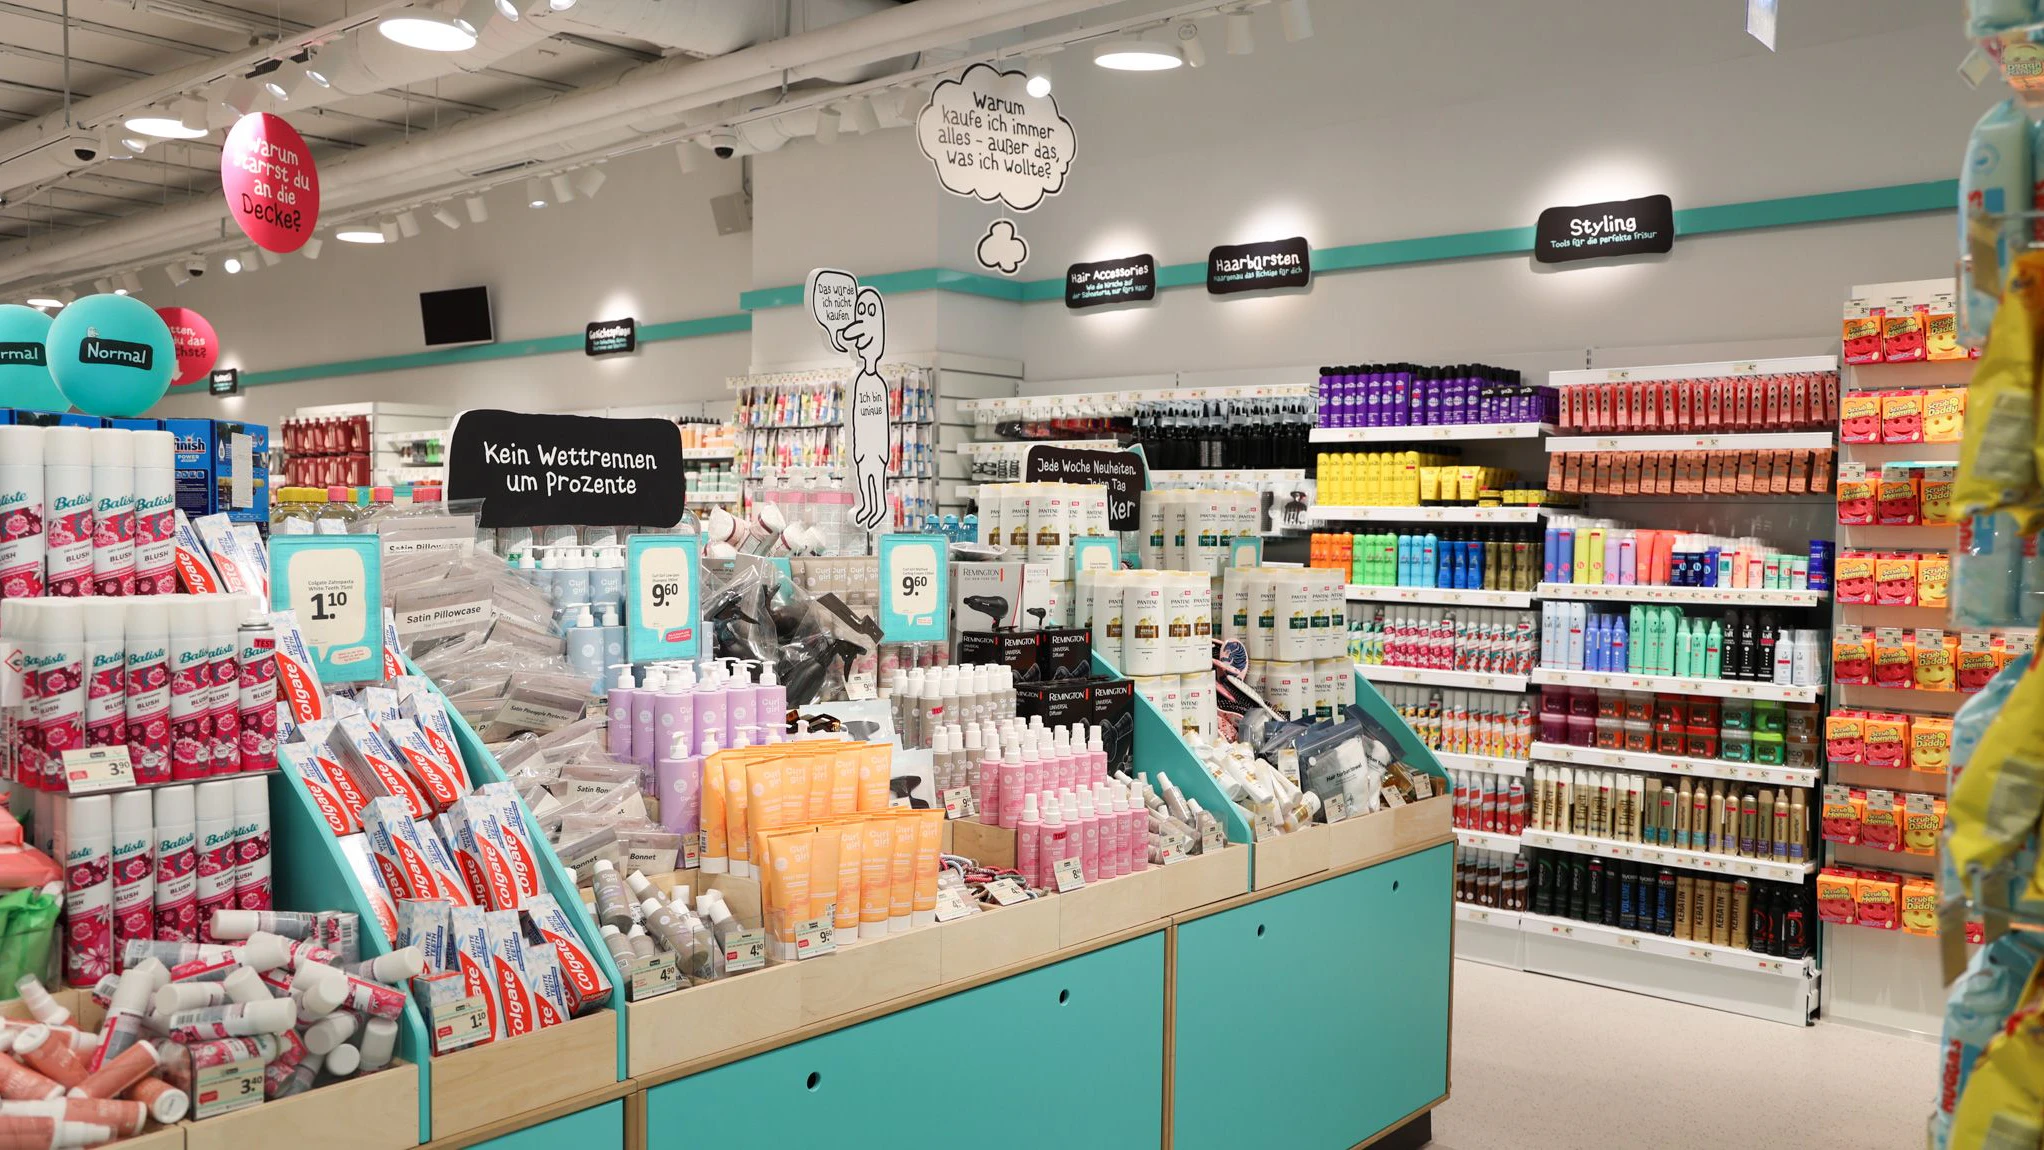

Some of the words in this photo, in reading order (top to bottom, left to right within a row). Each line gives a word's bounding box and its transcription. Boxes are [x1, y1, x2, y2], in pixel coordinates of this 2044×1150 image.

[942, 104, 982, 129] kaufe
[987, 114, 1007, 132] ich
[1012, 118, 1055, 139] immer
[938, 127, 971, 146] alles
[987, 136, 1029, 155] außer
[1034, 142, 1060, 163] das,
[979, 152, 999, 171] ich
[294, 170, 311, 191] du
[254, 179, 273, 199] an
[276, 184, 297, 206] die
[242, 193, 302, 233] Decke?
[1570, 215, 1637, 237] Styling
[1550, 239, 1571, 249] Tools
[1572, 237, 1585, 247] für
[1586, 236, 1598, 246] die
[1599, 233, 1632, 247] perfekte
[1215, 253, 1301, 273] Haarbürsten
[1071, 271, 1092, 284] Hair
[1092, 263, 1149, 281] Accessories
[818, 283, 832, 295] Das
[833, 283, 855, 296] würde
[822, 296, 833, 308] ich
[834, 297, 852, 308] nicht
[826, 309, 850, 321] kaufen
[187, 336, 206, 346] das
[0, 347, 39, 360] rmal
[87, 341, 147, 365] Normal
[859, 392, 871, 403] Ich
[872, 391, 882, 403] bin
[860, 405, 883, 417] unique
[1928, 406, 1958, 417] Daddy
[484, 441, 531, 466] Kein
[537, 443, 658, 470] Wettrennen
[1037, 458, 1060, 473] Jede
[1062, 459, 1091, 473] Woche
[1093, 460, 1137, 476] Neuheiten.
[506, 473, 539, 493] um
[1112, 478, 1127, 492] Tag
[1109, 495, 1136, 520] ker
[144, 551, 169, 562] BLUSH
[902, 576, 928, 597] 9.60
[652, 583, 679, 608] 9.60
[310, 592, 348, 621] 1.10
[407, 613, 432, 625] Satin
[434, 605, 482, 621] Pillowcase
[1004, 637, 1036, 648] REMINGTON
[1052, 634, 1085, 645] REMINGTON
[128, 648, 166, 665] Batiste
[1918, 650, 1941, 660] Scrub
[1919, 656, 1949, 666] Daddy
[1962, 660, 1995, 669] Mommy
[287, 662, 314, 723] Colgate
[1049, 691, 1085, 701] REMINGTON
[1095, 686, 1128, 697] REMINGTON
[136, 699, 160, 710] BLUSH
[762, 698, 780, 706] Curl
[510, 705, 523, 713] Satin
[523, 705, 547, 718] Pineapple
[766, 705, 780, 715] girl
[1914, 732, 1939, 741] Scrub
[1916, 738, 1946, 748] Daddy
[414, 754, 451, 799] Colgate
[377, 764, 417, 815] Colgate
[577, 785, 595, 794] Satin
[310, 786, 344, 832] Colgate
[1908, 815, 1931, 824] Scrub
[1908, 821, 1938, 831] Daddy
[870, 830, 890, 840] Curl
[874, 839, 890, 848] girl
[571, 856, 598, 870] Bonnet
[630, 852, 656, 862] Bonnet
[509, 834, 532, 898] Colgate
[486, 845, 512, 909] Colgate
[170, 882, 191, 895] BLUSH
[1621, 882, 1631, 913] VOLUME
[1677, 891, 1686, 923] KERATIN
[1695, 894, 1704, 926] KERATIN
[557, 939, 594, 990] Colgate
